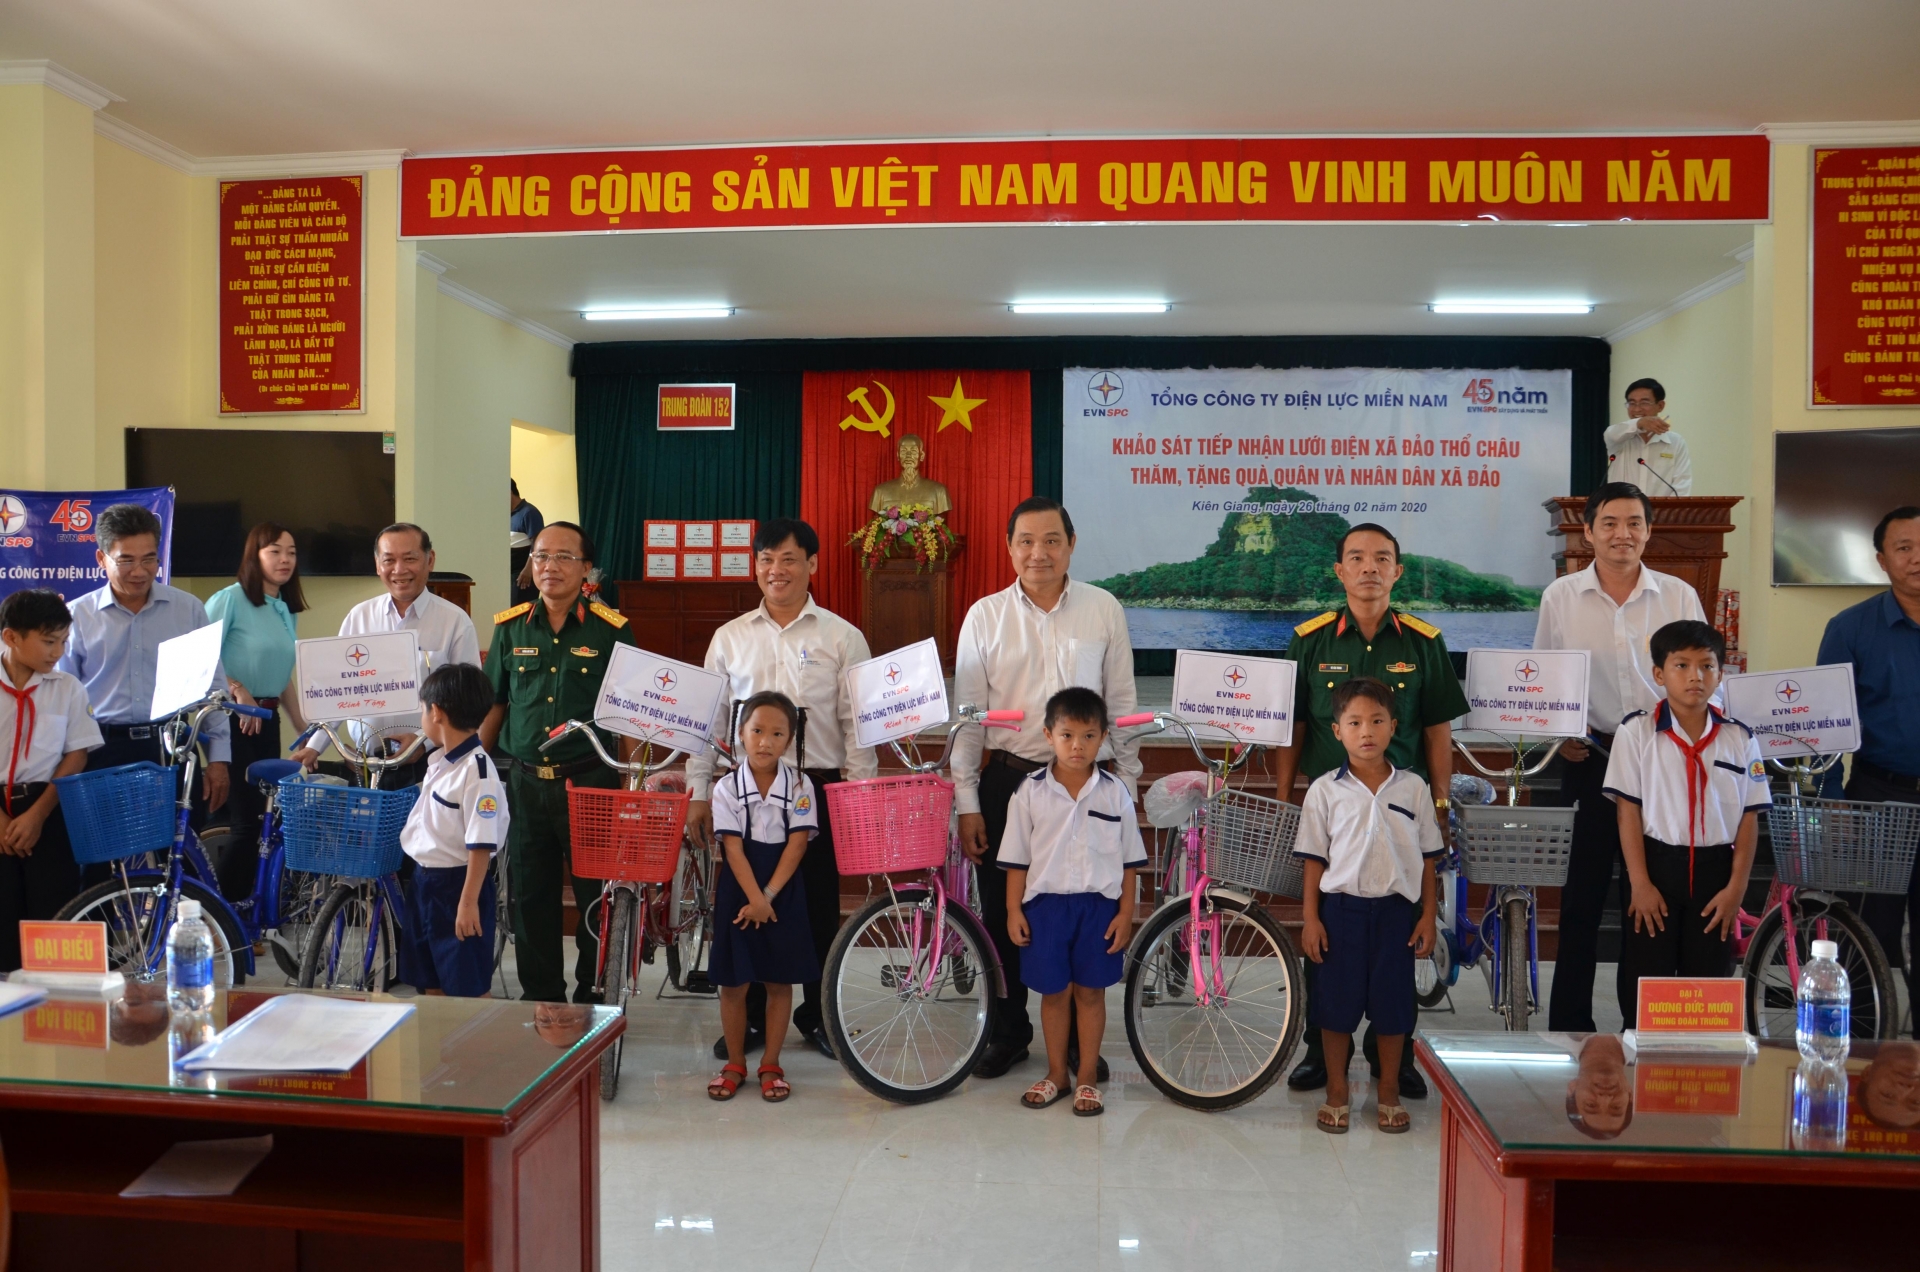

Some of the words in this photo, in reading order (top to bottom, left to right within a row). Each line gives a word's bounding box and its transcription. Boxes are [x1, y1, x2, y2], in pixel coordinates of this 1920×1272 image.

[428, 164, 550, 218] ĐẢNG
[570, 166, 691, 224] CỘNG
[712, 154, 809, 212] SẢN
[830, 156, 939, 216] VIỆT
[960, 162, 1077, 206] NAM
[1099, 161, 1266, 208] QUANG
[1290, 161, 1406, 203] VINH
[1429, 151, 1582, 204] MUÔN
[1607, 150, 1730, 203] NĂM
[298, 188, 308, 197] TA
[324, 293, 335, 302] TA
[276, 309, 302, 318] TRONG
[274, 354, 300, 364] TRUNG
[1462, 378, 1495, 404] 45
[1498, 387, 1548, 404] năm
[1151, 386, 1198, 406] TỔNG
[1204, 390, 1256, 406] CÔNG
[1260, 393, 1279, 406] TY
[1284, 390, 1321, 410] ĐIỆN
[1328, 393, 1358, 410] LỰC
[1364, 388, 1404, 406] MIỀN
[1409, 394, 1448, 407] NAM
[662, 397, 687, 417] TRUNG
[690, 393, 712, 417] ĐOÀN
[714, 397, 729, 417] 152
[1083, 408, 1129, 417] EVNSPC
[1112, 432, 1156, 455] KHẢO
[1162, 434, 1192, 455] SÁT
[1198, 432, 1232, 456] TIẾP
[1238, 435, 1284, 459] NHẬN
[1290, 435, 1326, 456] LƯỚI
[1331, 436, 1370, 459] ĐIỆN
[1375, 436, 1398, 456] XÃ
[1402, 434, 1434, 456] ĐẢO
[1440, 434, 1472, 457] THỔ
[1476, 438, 1520, 458] CHÂU
[1131, 464, 1182, 486] THĂM,
[1187, 464, 1230, 488] TẶNG
[1236, 464, 1268, 486] QUÀ
[1274, 465, 1318, 486] QUÂN
[1324, 464, 1345, 485] VÀ
[1350, 465, 1397, 486] NHÂN
[1402, 466, 1434, 486] DÂN
[1441, 466, 1462, 486] XÃ
[1468, 464, 1500, 487] ĐẢO
[1192, 501, 1219, 511] Kiên
[1223, 501, 1262, 513] Giang,
[1265, 502, 1294, 514] ngày
[1298, 502, 1312, 512] 26
[1316, 502, 1350, 514] tháng
[1354, 502, 1367, 512] 02
[1371, 502, 1397, 512] năm
[1401, 502, 1428, 512] 2020
[50, 500, 92, 532] 45
[8, 566, 40, 578] CÔNG
[42, 568, 55, 578] TY
[57, 566, 84, 582] ĐIỆN
[86, 567, 106, 582] LỰC
[341, 669, 376, 678] EVNSPC
[401, 681, 414, 689] NAM
[643, 690, 677, 705] EVNSPC
[1216, 691, 1251, 700] EVNSPC
[1566, 702, 1580, 711] NAM
[1772, 706, 1809, 715] EVNSPC
[1273, 711, 1286, 721] NAM
[694, 721, 707, 732] NAM
[1837, 718, 1851, 726] NAM
[34, 938, 58, 964] ĐẠI
[62, 931, 93, 961] BIỂU
[1680, 990, 1692, 999] ĐẠI
[1694, 989, 1703, 997] TÁ
[1648, 1002, 1682, 1012] DƯƠNG
[1684, 1000, 1704, 1012] ĐỨC
[1708, 1000, 1733, 1012] MƯỜI
[1652, 1017, 1676, 1025] TRUNG
[1678, 1016, 1698, 1025] ĐOÀN
